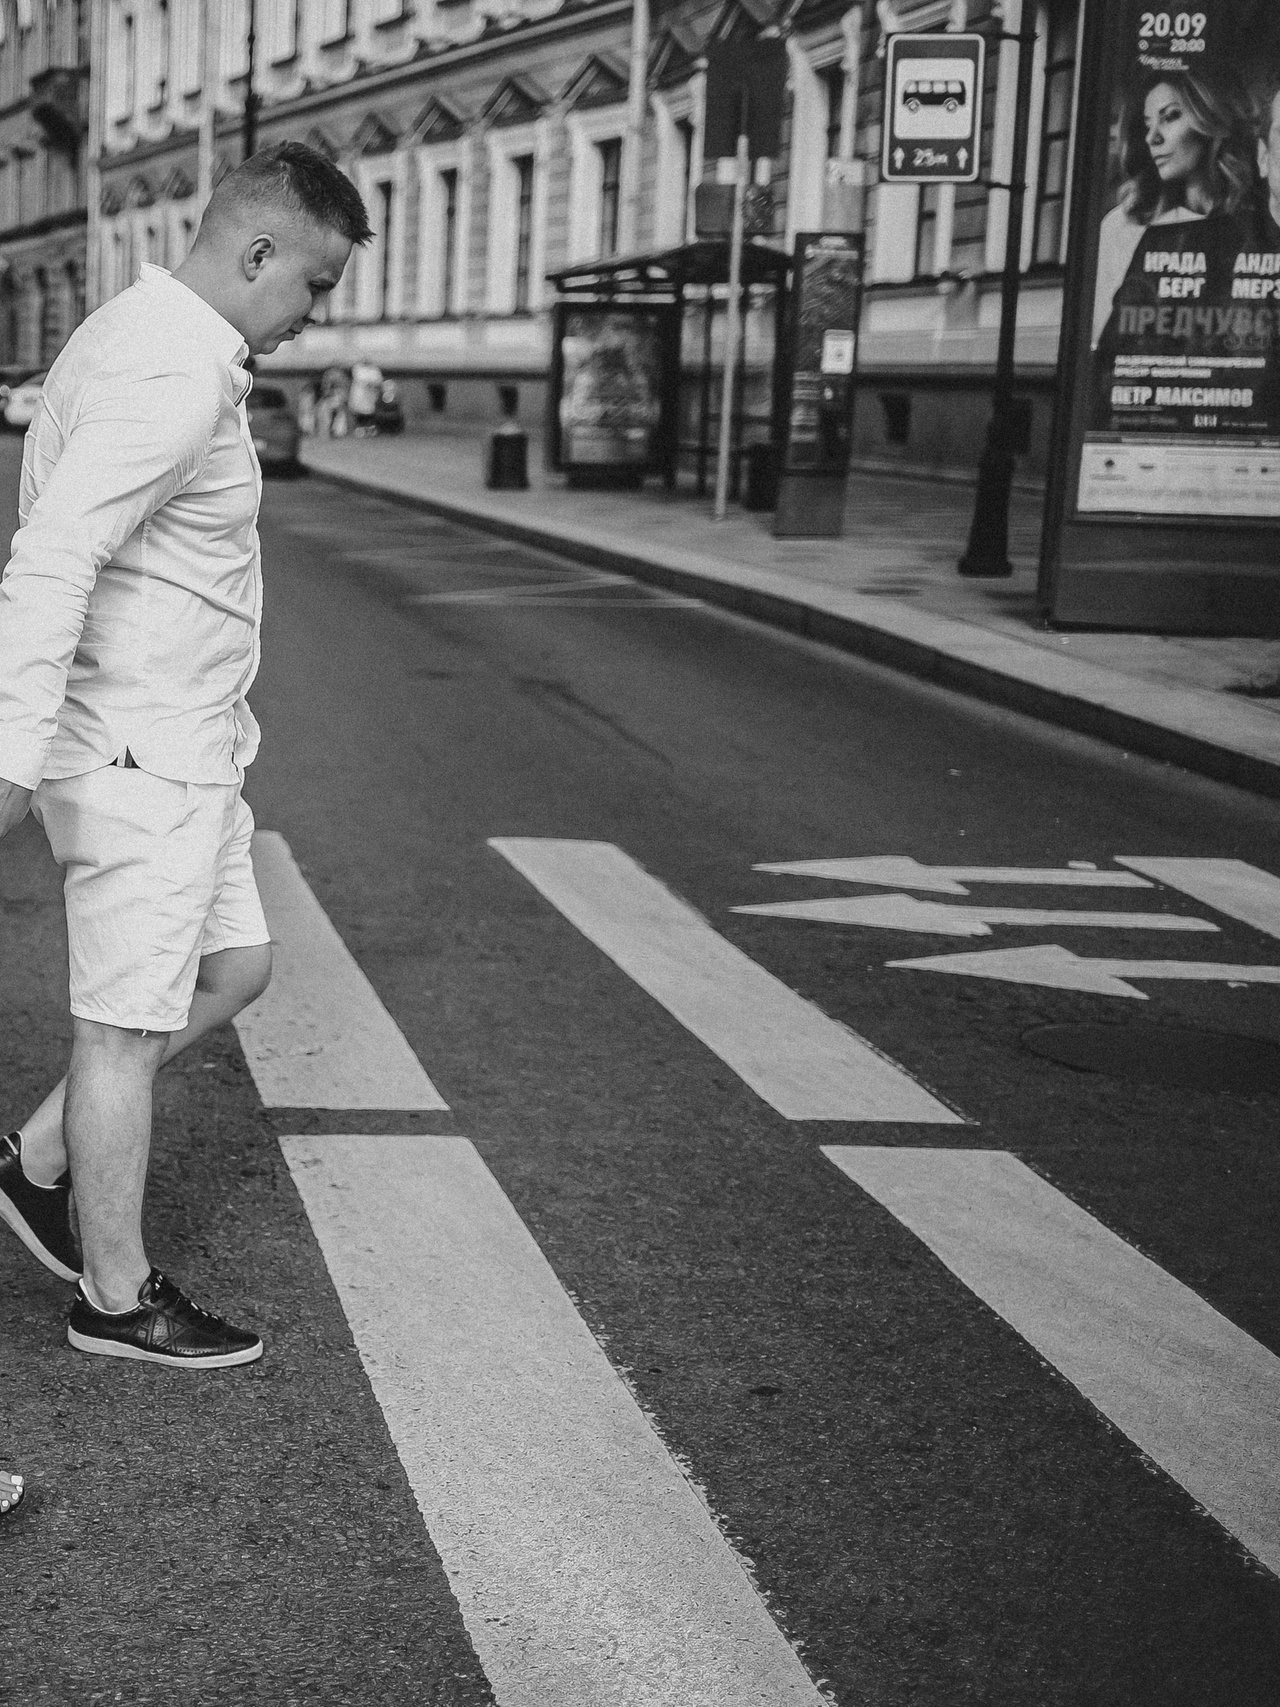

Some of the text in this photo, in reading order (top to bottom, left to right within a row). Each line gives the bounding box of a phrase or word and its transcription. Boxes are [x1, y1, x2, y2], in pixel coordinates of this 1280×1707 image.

[1138, 12, 1207, 37] 20.09
[1143, 251, 1207, 275] ИРАДА
[1157, 277, 1206, 299] БЕРГ
[1118, 305, 1280, 338] ПРЕДЧУВС
[1111, 385, 1254, 408] ПЕТР МАКСИМОВ
